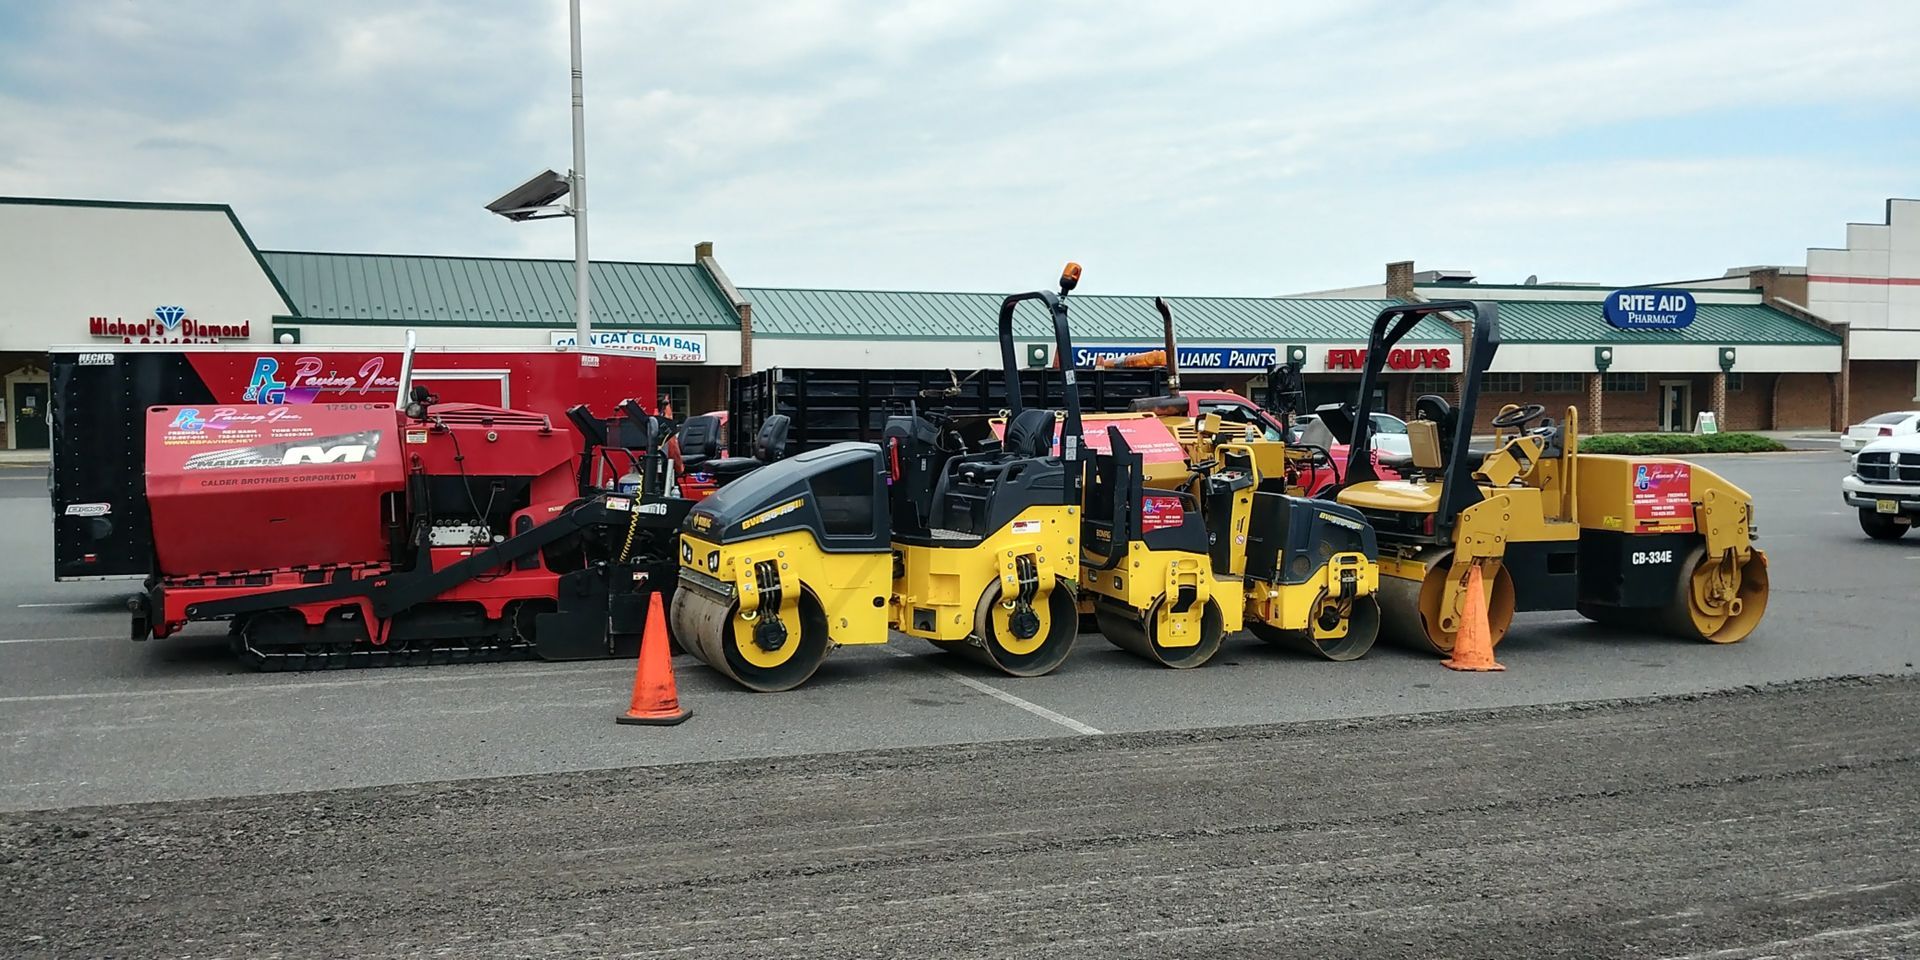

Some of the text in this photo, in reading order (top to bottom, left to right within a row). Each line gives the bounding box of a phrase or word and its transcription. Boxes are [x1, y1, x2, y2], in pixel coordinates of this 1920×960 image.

[1619, 294, 1687, 312] RITE AID
[1628, 312, 1677, 324] PHARMACY
[89, 317, 249, 337] Michael's Diamond
[600, 332, 628, 345] CAT
[632, 333, 671, 347] CLAM
[674, 338, 701, 354] BAR
[1179, 352, 1222, 367] LIAMS
[1228, 351, 1276, 367] PAINTS
[1327, 348, 1451, 370] FIV GUYS
[290, 357, 356, 395] Paving
[359, 357, 400, 395] Inc.
[209, 408, 266, 424] Paving
[201, 473, 357, 487] CALDER BROTHERS CORPORATION
[1632, 550, 1672, 565] CB-334E
